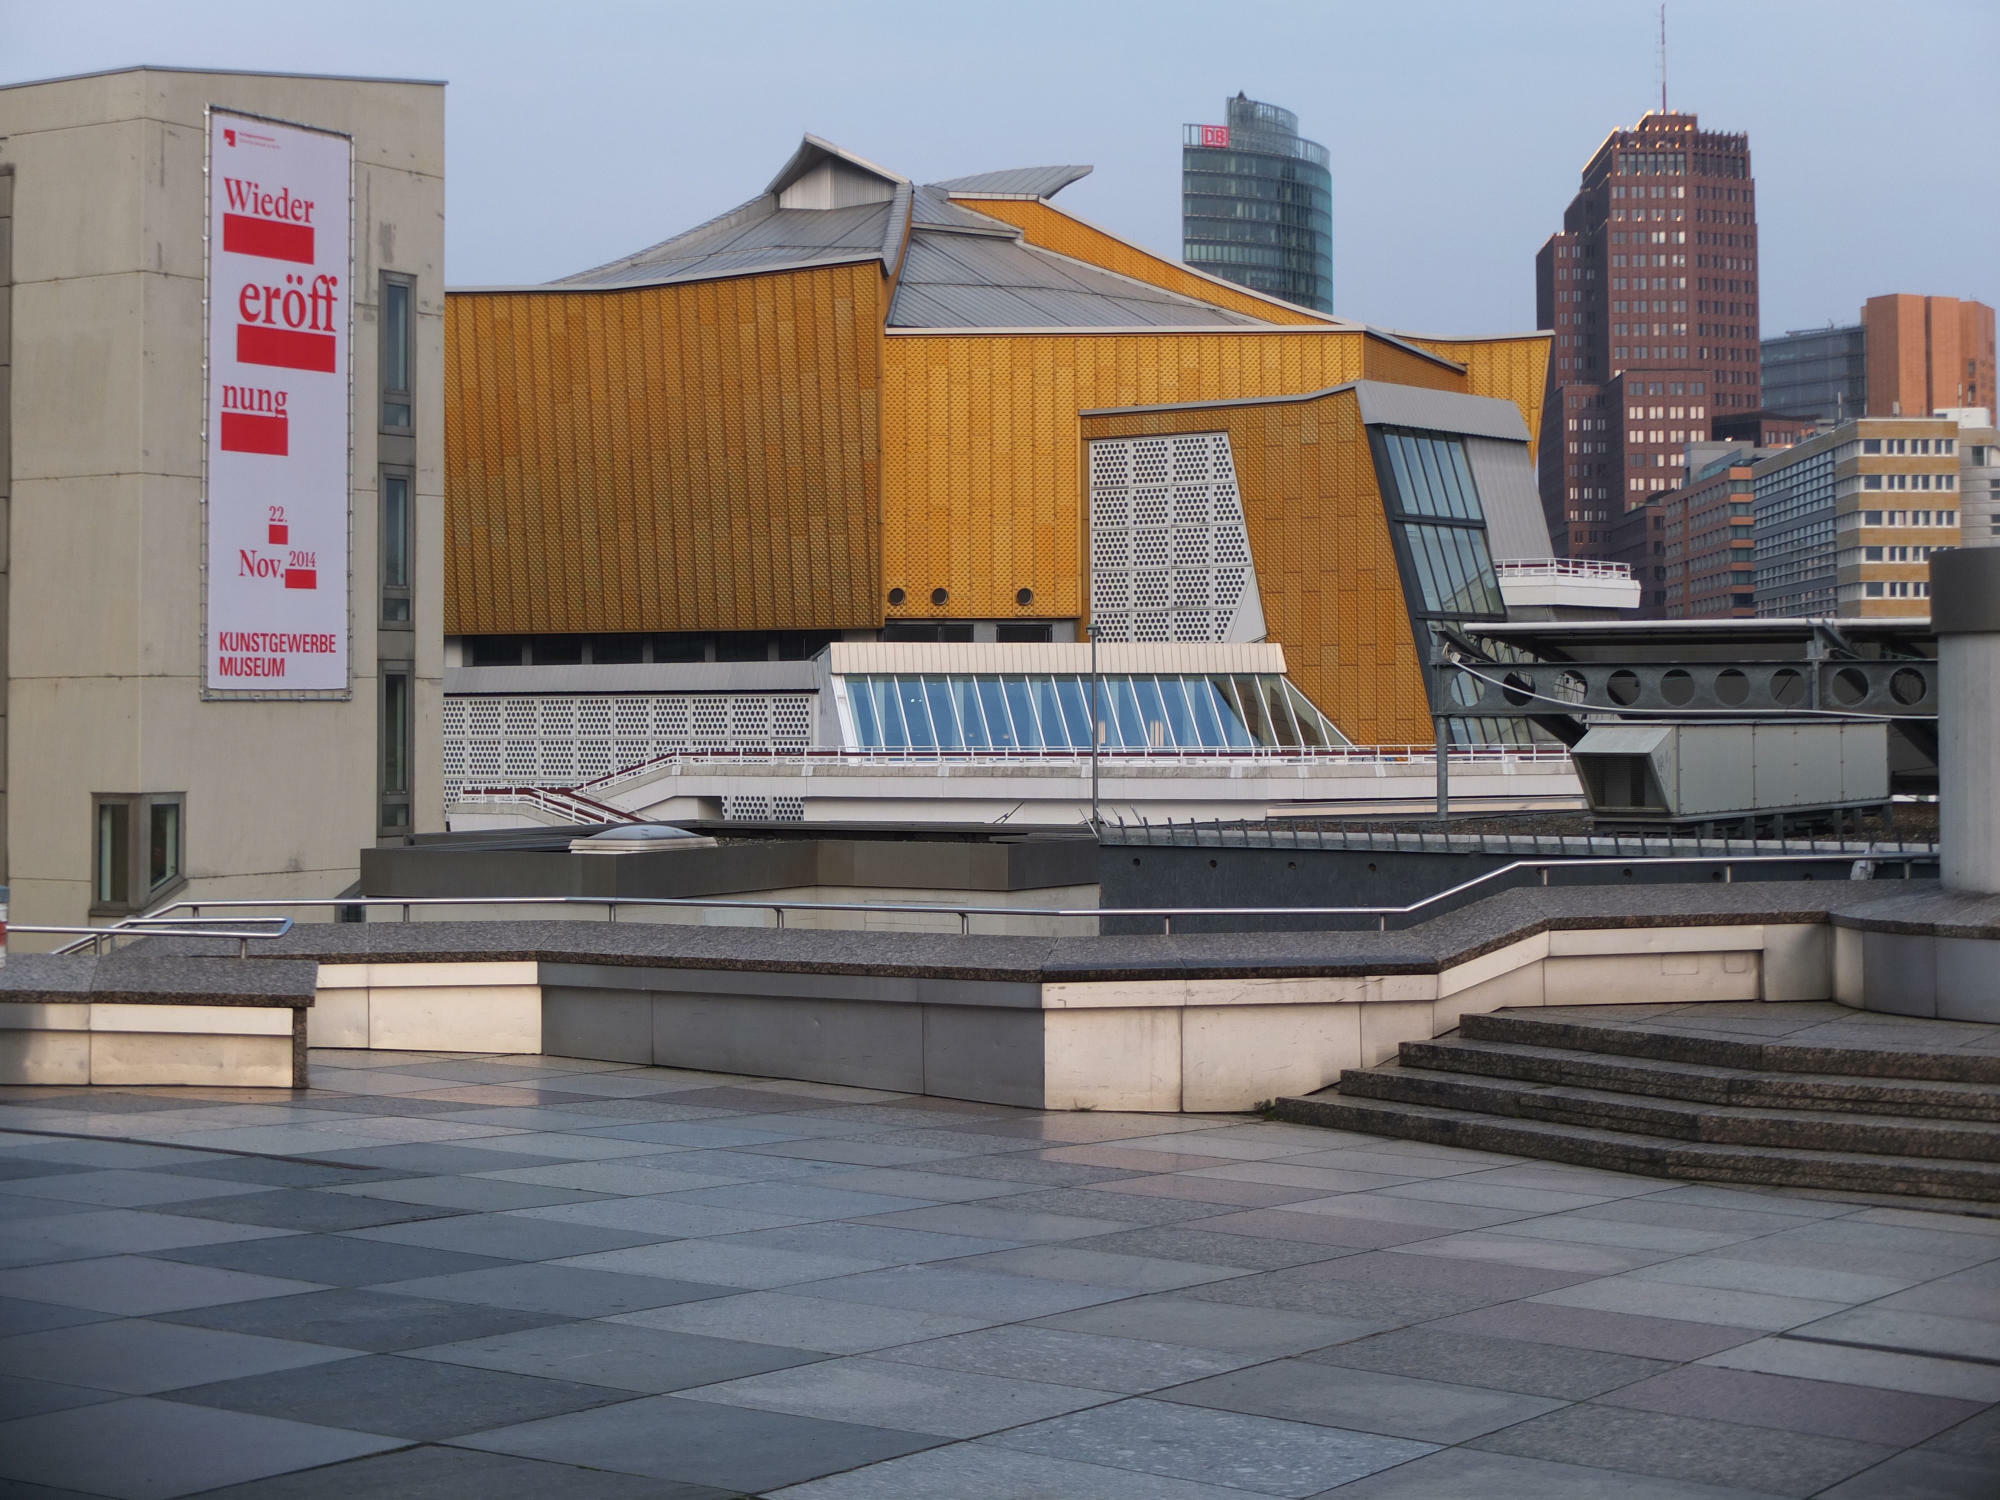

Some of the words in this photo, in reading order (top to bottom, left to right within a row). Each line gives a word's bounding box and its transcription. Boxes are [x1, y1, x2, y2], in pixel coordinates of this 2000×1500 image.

[1205, 128, 1225, 144] DB
[223, 177, 314, 223] Wieder
[238, 273, 338, 332] eröff
[222, 384, 288, 419] nung
[269, 505, 288, 523] 22.
[238, 549, 285, 578] Nov.
[289, 550, 316, 568] 2014
[219, 631, 336, 654] KUNSTGEWERBE
[219, 656, 285, 677] MUSEUM
